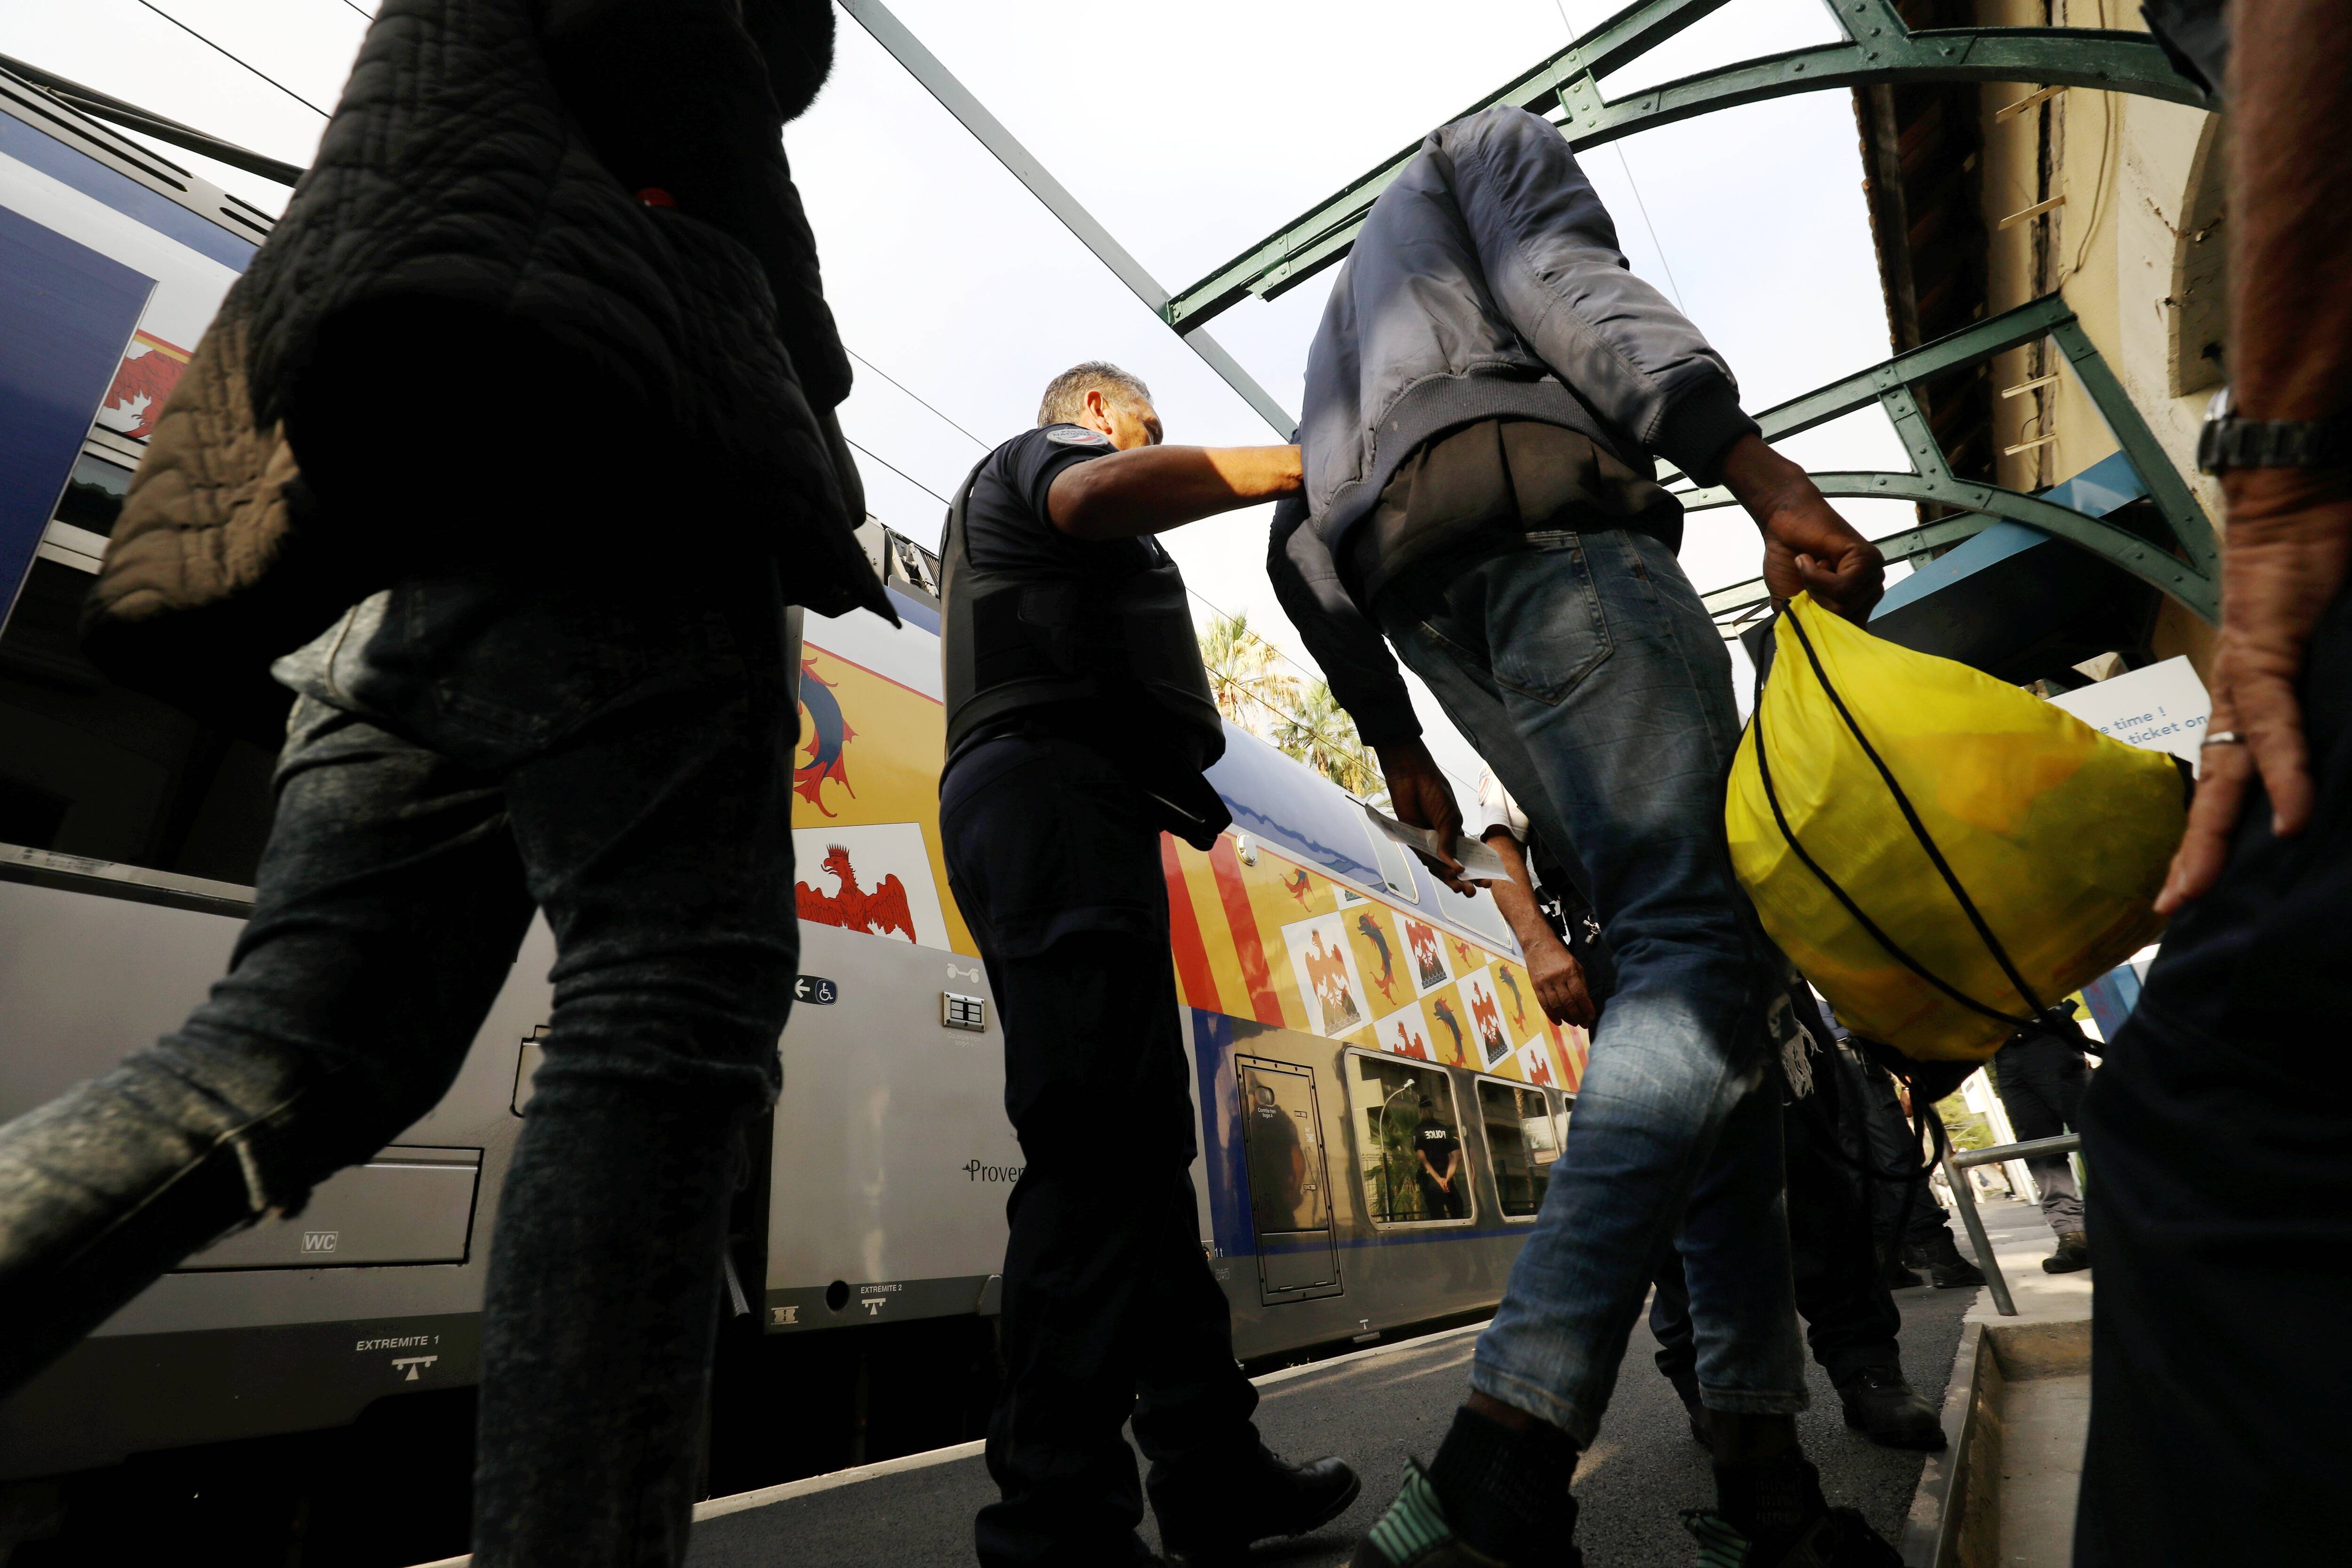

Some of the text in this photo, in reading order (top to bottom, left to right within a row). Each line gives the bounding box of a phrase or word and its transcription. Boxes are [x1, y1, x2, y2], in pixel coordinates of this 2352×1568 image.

[2114, 713, 2153, 731] time
[2159, 706, 2167, 716] !
[2128, 715, 2208, 744] ticket on
[305, 1234, 335, 1250] WC
[860, 1285, 897, 1294] EXTREMITE
[356, 1335, 440, 1351] EXTREMITE 1
